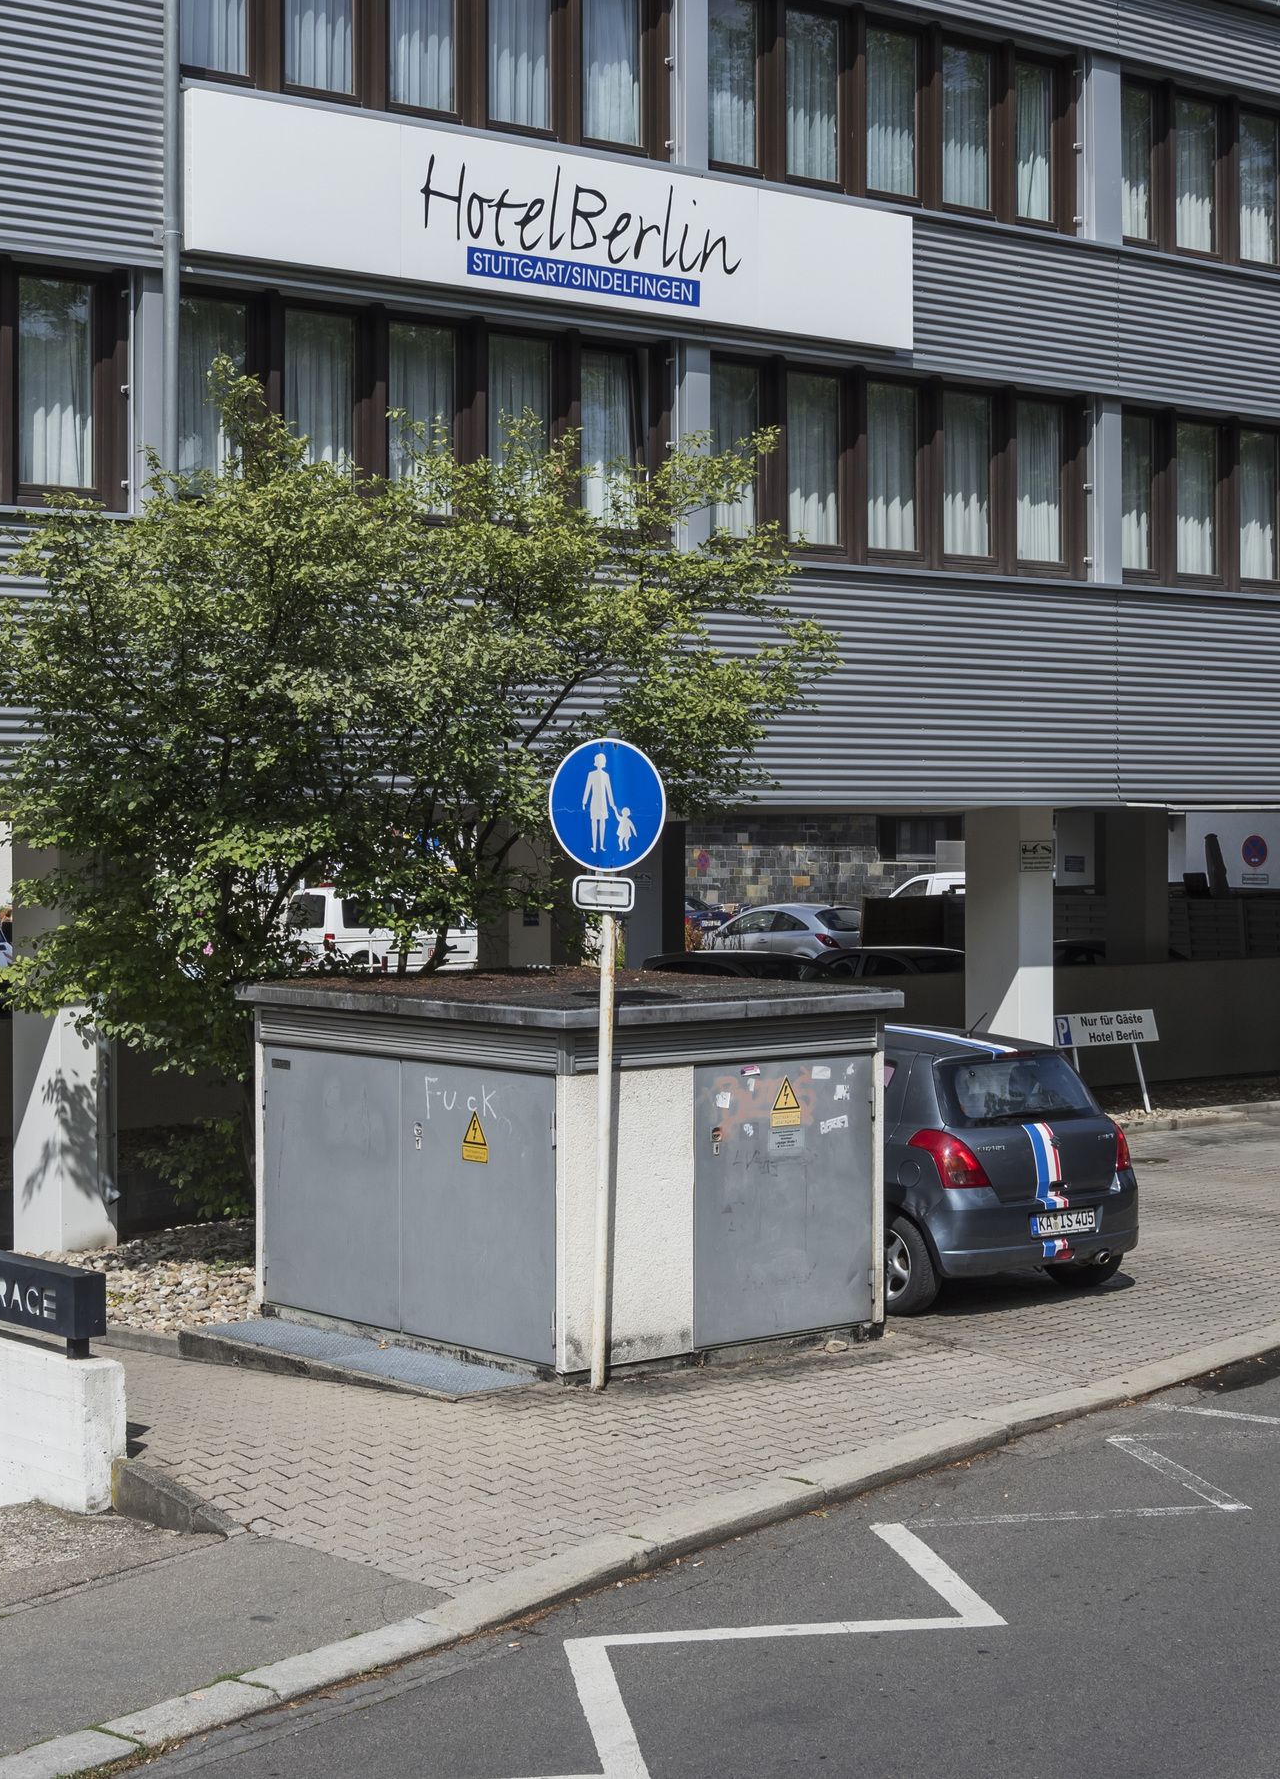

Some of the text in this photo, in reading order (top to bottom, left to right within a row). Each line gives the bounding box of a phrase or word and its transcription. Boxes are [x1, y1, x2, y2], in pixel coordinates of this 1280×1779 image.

[472, 251, 693, 303] STUTTGART/SINDELFINGEN
[1080, 1013, 1143, 1027] Nur für Gäste
[1088, 1029, 1144, 1043] Hotel Berlin
[1039, 1210, 1094, 1231] KA IS 405
